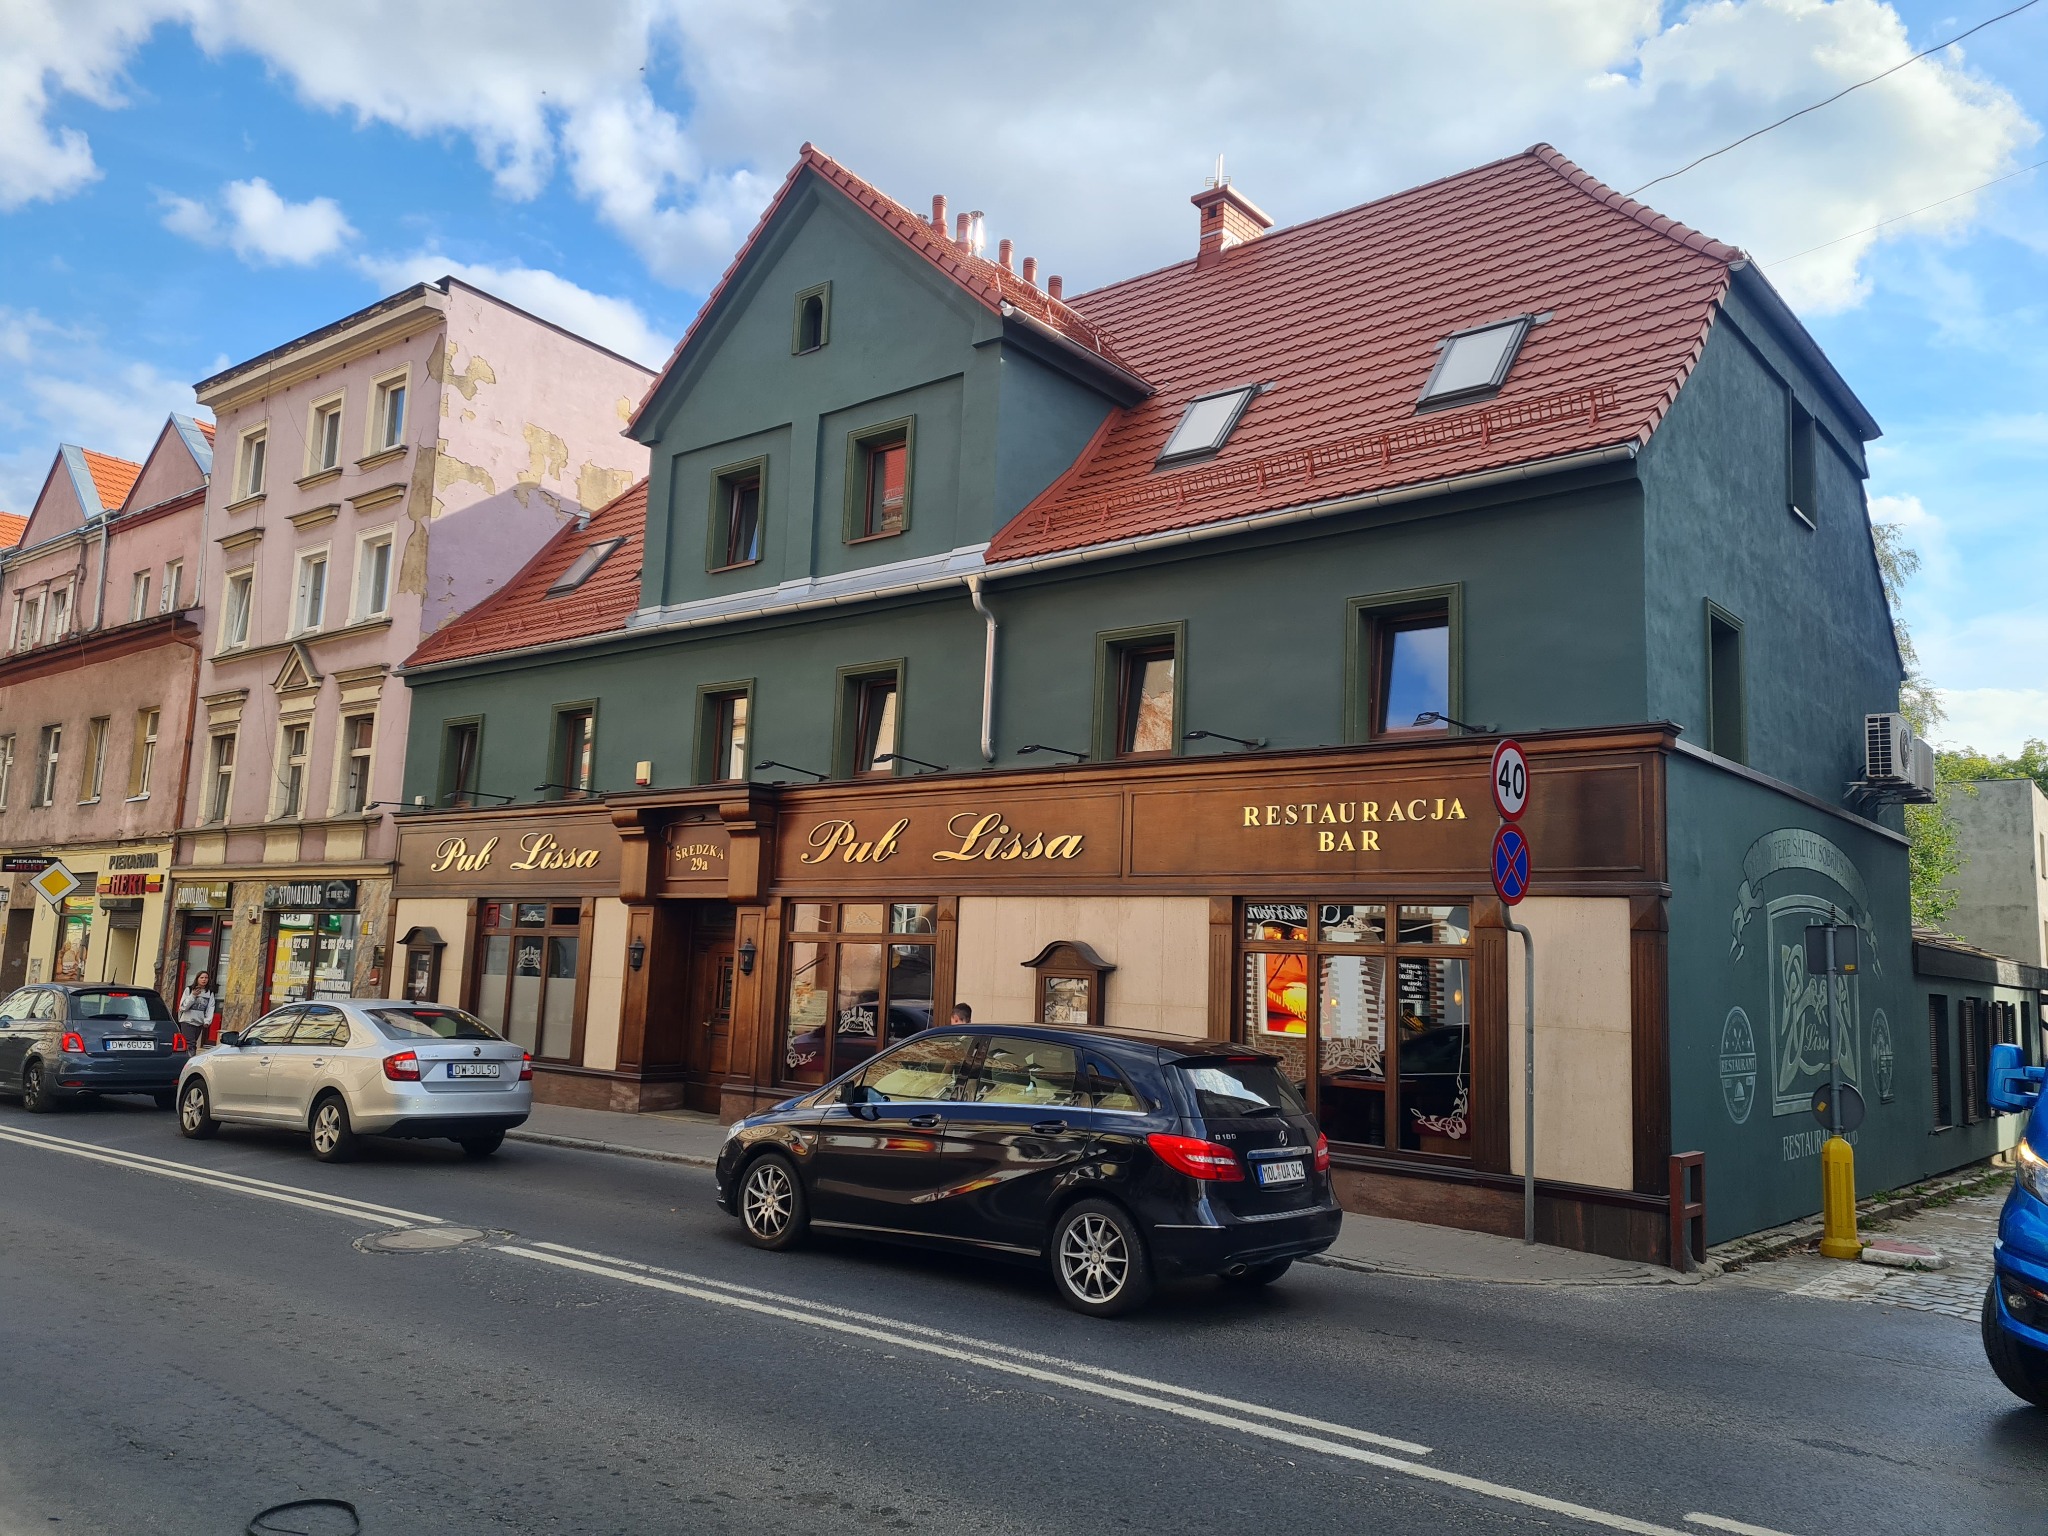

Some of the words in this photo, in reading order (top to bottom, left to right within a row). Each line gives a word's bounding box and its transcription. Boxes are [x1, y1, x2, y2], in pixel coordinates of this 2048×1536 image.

[1499, 760, 1524, 799] 40
[1243, 798, 1467, 827] RESTAURACJA
[800, 818, 909, 864] Pub
[932, 812, 1083, 860] Lissa
[1318, 830, 1381, 852] BAR
[109, 853, 158, 870] PIEKARNIA
[430, 836, 499, 872] Pub
[509, 832, 601, 870] Lissa
[675, 844, 725, 861] ŚREDZKA
[690, 857, 708, 871] 29a
[110, 875, 146, 896] HERT
[278, 885, 322, 905] STOMATOLOG
[111, 1042, 124, 1050] DW
[126, 1041, 153, 1049] 6GU25
[454, 1065, 467, 1075] DW
[470, 1064, 497, 1075] 3UL50
[1721, 1056, 1756, 1073] RESTAURANT
[1262, 1166, 1278, 1181] MOL
[1280, 1163, 1291, 1178] UA
